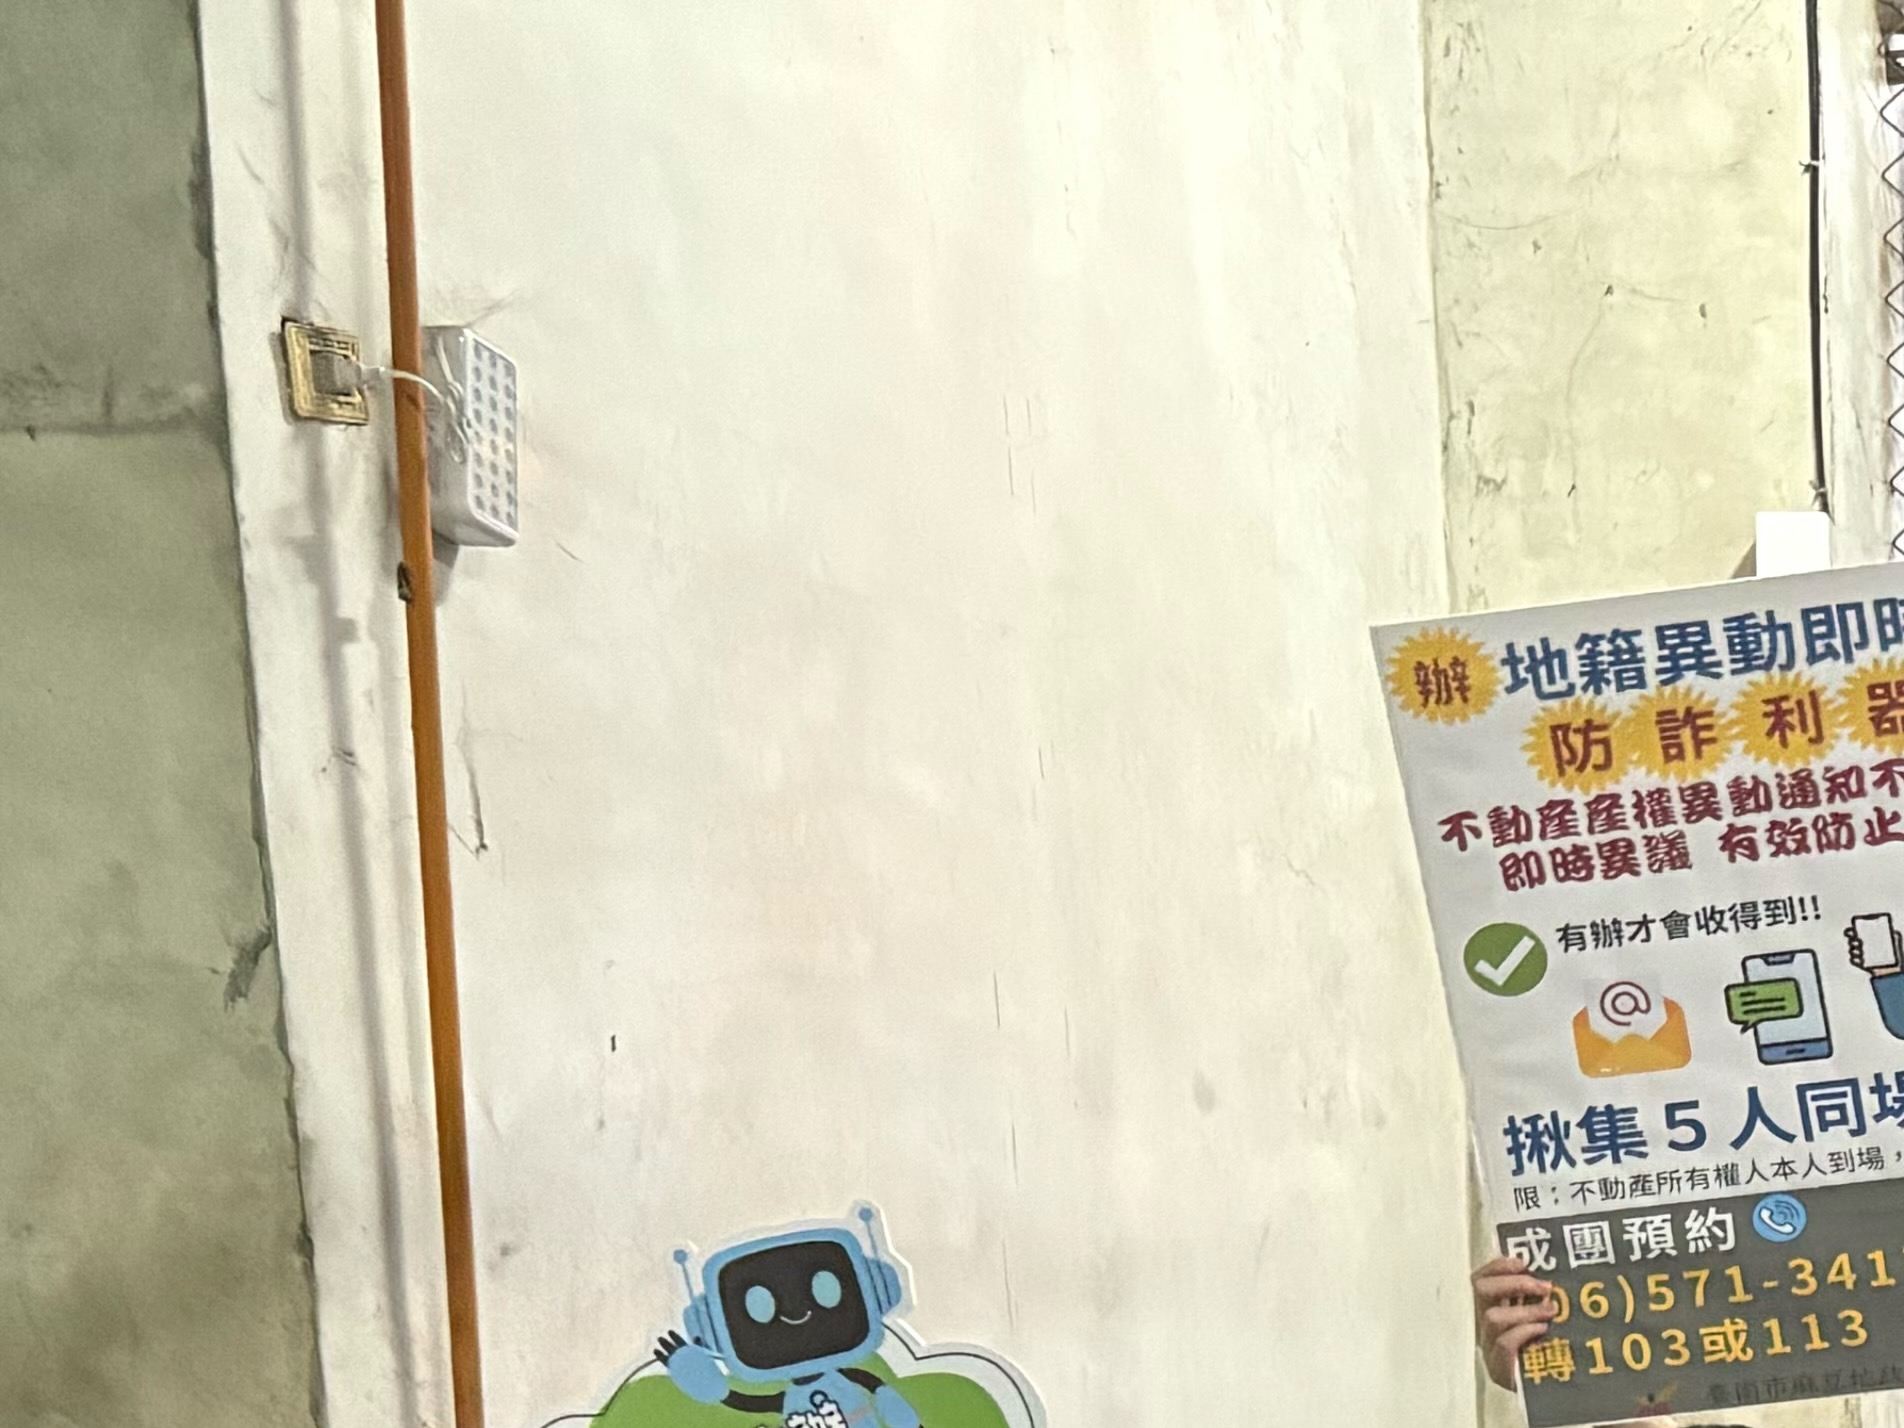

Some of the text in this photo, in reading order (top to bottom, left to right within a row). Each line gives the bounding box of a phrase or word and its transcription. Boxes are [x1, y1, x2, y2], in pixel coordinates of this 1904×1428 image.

[1414, 656, 1472, 707] 辦
[1500, 830, 1692, 894] 即時異議
[1556, 894, 1824, 953] 有辦才會收得到!!
[1504, 1205, 1736, 1274] 成團預約
[1522, 1308, 1870, 1385] 轉103或113
